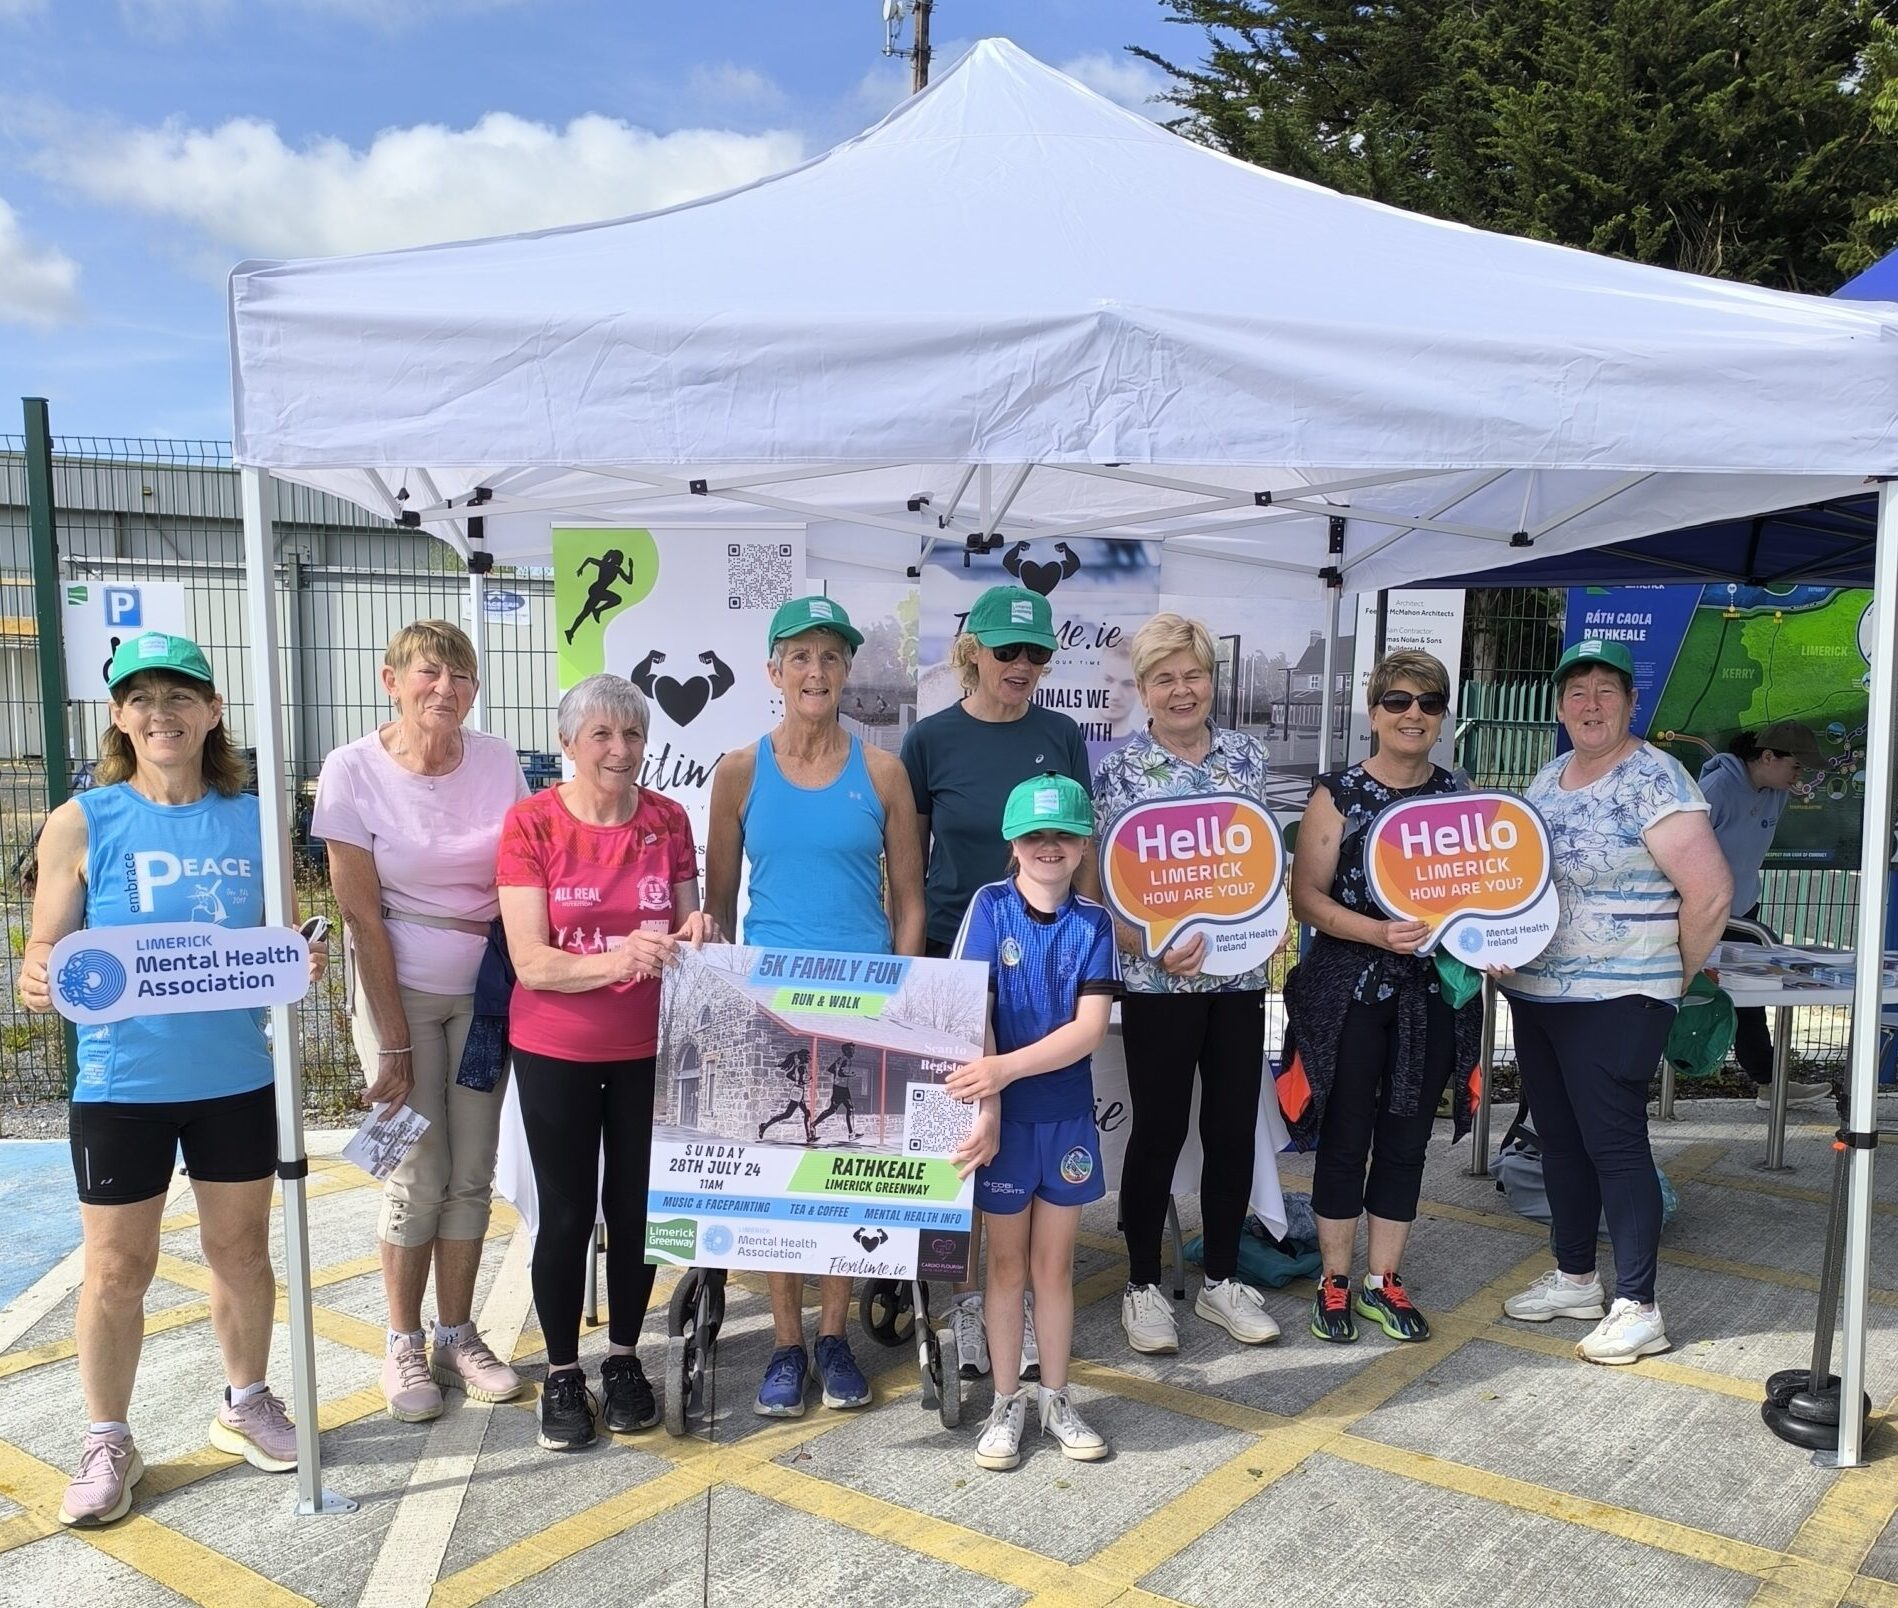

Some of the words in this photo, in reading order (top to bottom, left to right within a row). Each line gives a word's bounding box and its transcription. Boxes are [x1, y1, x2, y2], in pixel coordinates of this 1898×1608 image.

[1395, 599, 1424, 607] Architect
[1421, 609, 1455, 617] Architects
[1585, 609, 1615, 624] RÁTH
[1616, 613, 1652, 625] CAOLA
[1584, 628, 1647, 641] RATHKEALE
[1800, 645, 1849, 657] LIMERICK
[1722, 668, 1756, 680] KERRY
[1086, 688, 1111, 709] WE
[1136, 815, 1252, 863] Hello
[1400, 812, 1518, 859] Hello
[1150, 861, 1244, 886] LIMERICK
[1415, 857, 1511, 882] LIMERICK
[124, 852, 140, 913] embrace
[1409, 885, 1446, 901] HOW
[1451, 881, 1481, 896] ARE
[1485, 877, 1524, 892] YOU?
[554, 887, 572, 902] ALL
[574, 887, 602, 902] REAL
[1143, 890, 1179, 905] HOW
[1184, 886, 1213, 901] ARE
[1218, 882, 1256, 897] YOU?
[1216, 931, 1247, 943] Mental
[1248, 928, 1278, 940] Health
[1485, 926, 1518, 938] Mental
[1519, 923, 1550, 935] Health
[136, 935, 213, 951] LIMERICK
[1216, 941, 1247, 952] Ireland
[1487, 936, 1518, 948] Ireland
[136, 950, 219, 973] Mental
[225, 945, 299, 967] Health
[759, 953, 788, 977] 5K
[789, 956, 863, 982] FAMILY
[864, 961, 903, 985] FUN
[137, 971, 275, 998] Association
[791, 992, 815, 1006] RUN
[817, 995, 826, 1007] &
[829, 995, 861, 1009] WALK
[923, 1043, 952, 1054] Scan
[955, 1046, 967, 1055] to
[921, 1059, 964, 1074] Registe
[685, 1144, 746, 1159] SUNDAY
[669, 1158, 704, 1173] 28TH
[708, 1160, 742, 1175] JULY
[744, 1162, 761, 1176] 24
[831, 1157, 927, 1180] RATHKEALE
[700, 1179, 724, 1190] 11AM
[825, 1179, 873, 1192] LIMERICK
[875, 1181, 930, 1195] GREENWAY
[662, 1196, 694, 1208] MUSIC
[695, 1199, 702, 1209] &
[705, 1199, 771, 1213] FACEPAINTING
[789, 1203, 808, 1215] TEA
[808, 1206, 815, 1216] &
[817, 1205, 850, 1218] COFFEE
[864, 1208, 901, 1221] MENTAL
[904, 1211, 939, 1223] HEALTH
[940, 1212, 962, 1225] INFO
[649, 1227, 696, 1238] Limerick
[649, 1235, 695, 1249] Greenway
[738, 1235, 777, 1247] Mental
[780, 1237, 818, 1249] Health
[737, 1246, 802, 1259] Association
